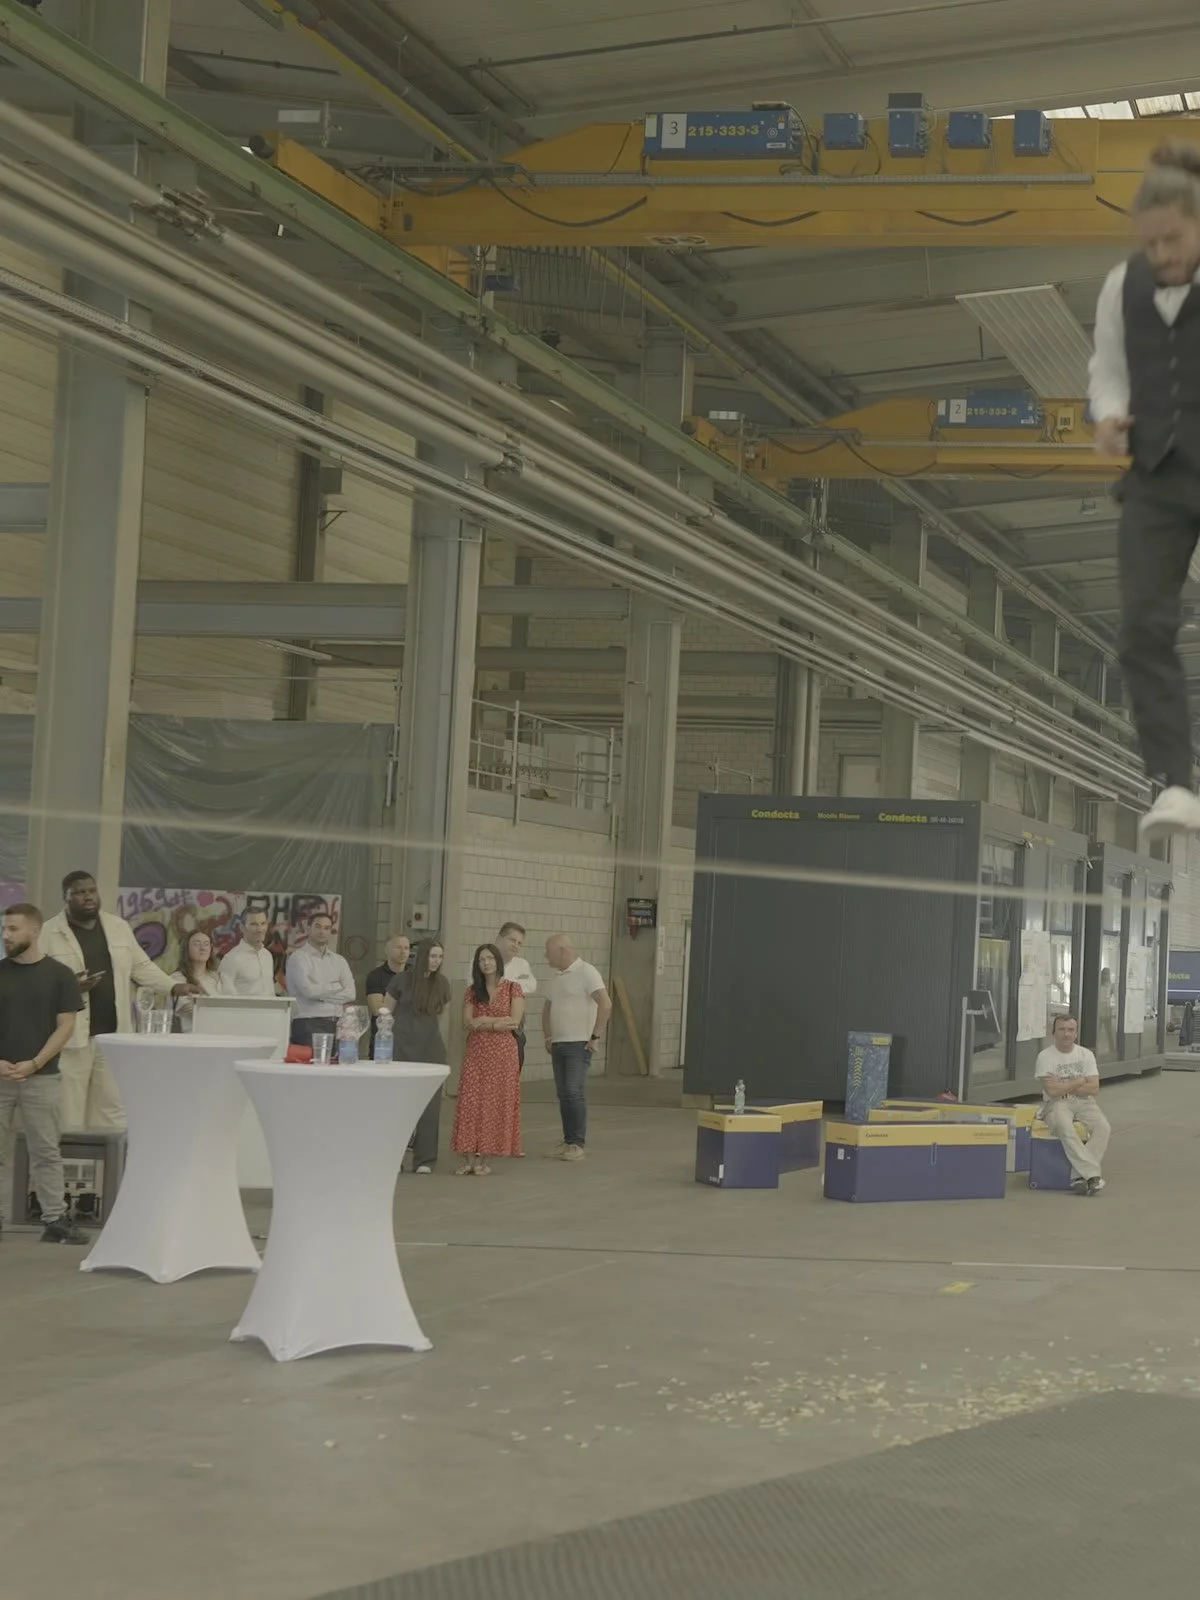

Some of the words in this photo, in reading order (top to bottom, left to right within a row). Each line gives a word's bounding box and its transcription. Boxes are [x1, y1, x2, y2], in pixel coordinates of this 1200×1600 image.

[669, 121, 678, 135] 3
[752, 809, 799, 819] Condecta
[878, 812, 928, 824] Condecta
